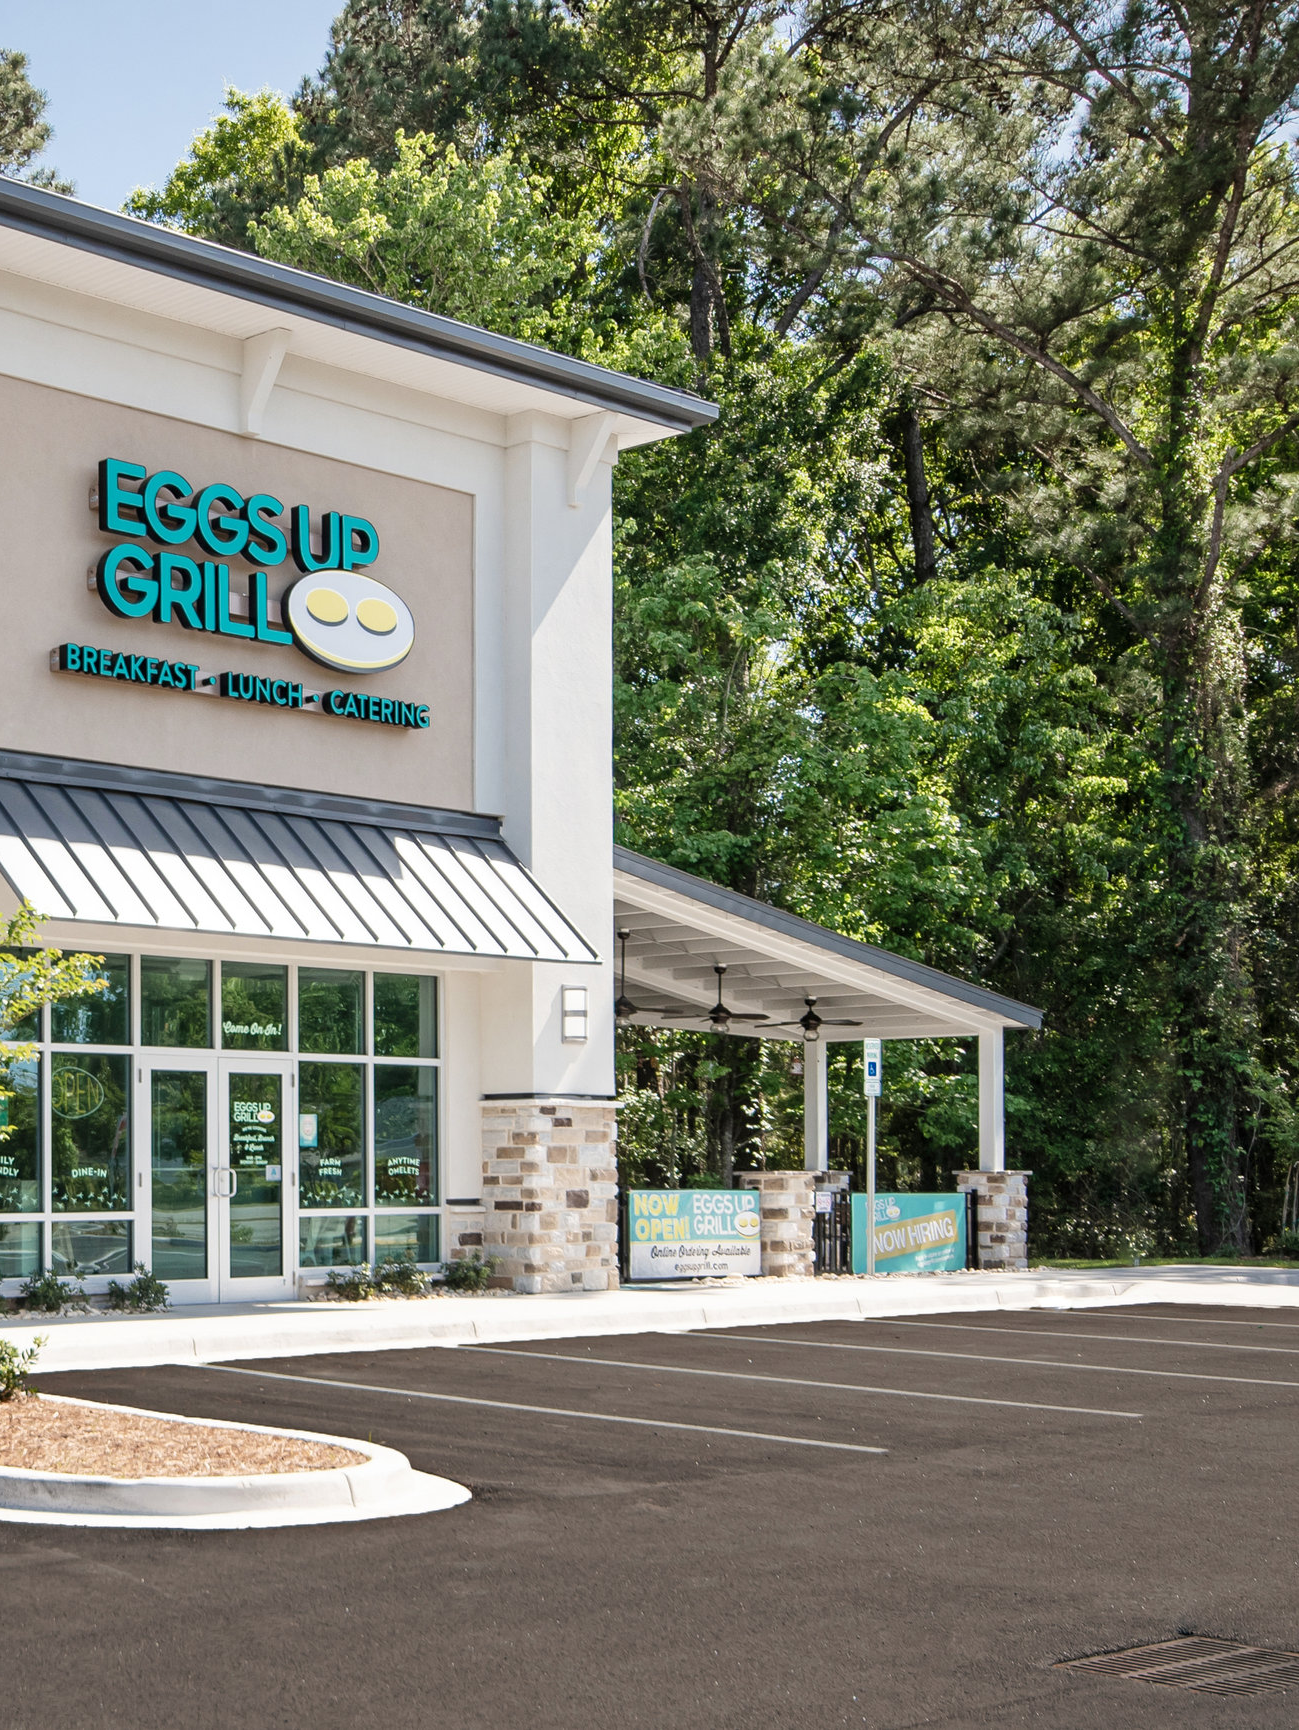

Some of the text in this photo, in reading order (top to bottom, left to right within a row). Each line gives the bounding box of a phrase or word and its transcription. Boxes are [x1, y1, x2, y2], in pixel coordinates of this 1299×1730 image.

[99, 458, 380, 573] EGGS UP
[98, 543, 293, 646] GRILL
[60, 642, 431, 729] BREAKFAST LUNCH CATERING
[223, 1021, 249, 1034] Come
[251, 1022, 264, 1036] On
[234, 1102, 272, 1112] EGGS UP
[234, 1112, 259, 1123] GRILL
[320, 1158, 341, 1167] FARM
[387, 1156, 420, 1167] ANYTIME
[71, 1167, 108, 1178] DINE-IN
[318, 1167, 342, 1176] FRESH
[387, 1166, 420, 1176] OMELETS
[633, 1193, 680, 1216] NOW
[693, 1194, 755, 1215] EGGS UP
[635, 1216, 690, 1241] OPEN!
[693, 1215, 736, 1236] GRILL
[874, 1227, 906, 1255] NOW
[907, 1217, 955, 1247] HIRING
[650, 1244, 751, 1260] Online Ordering Available
